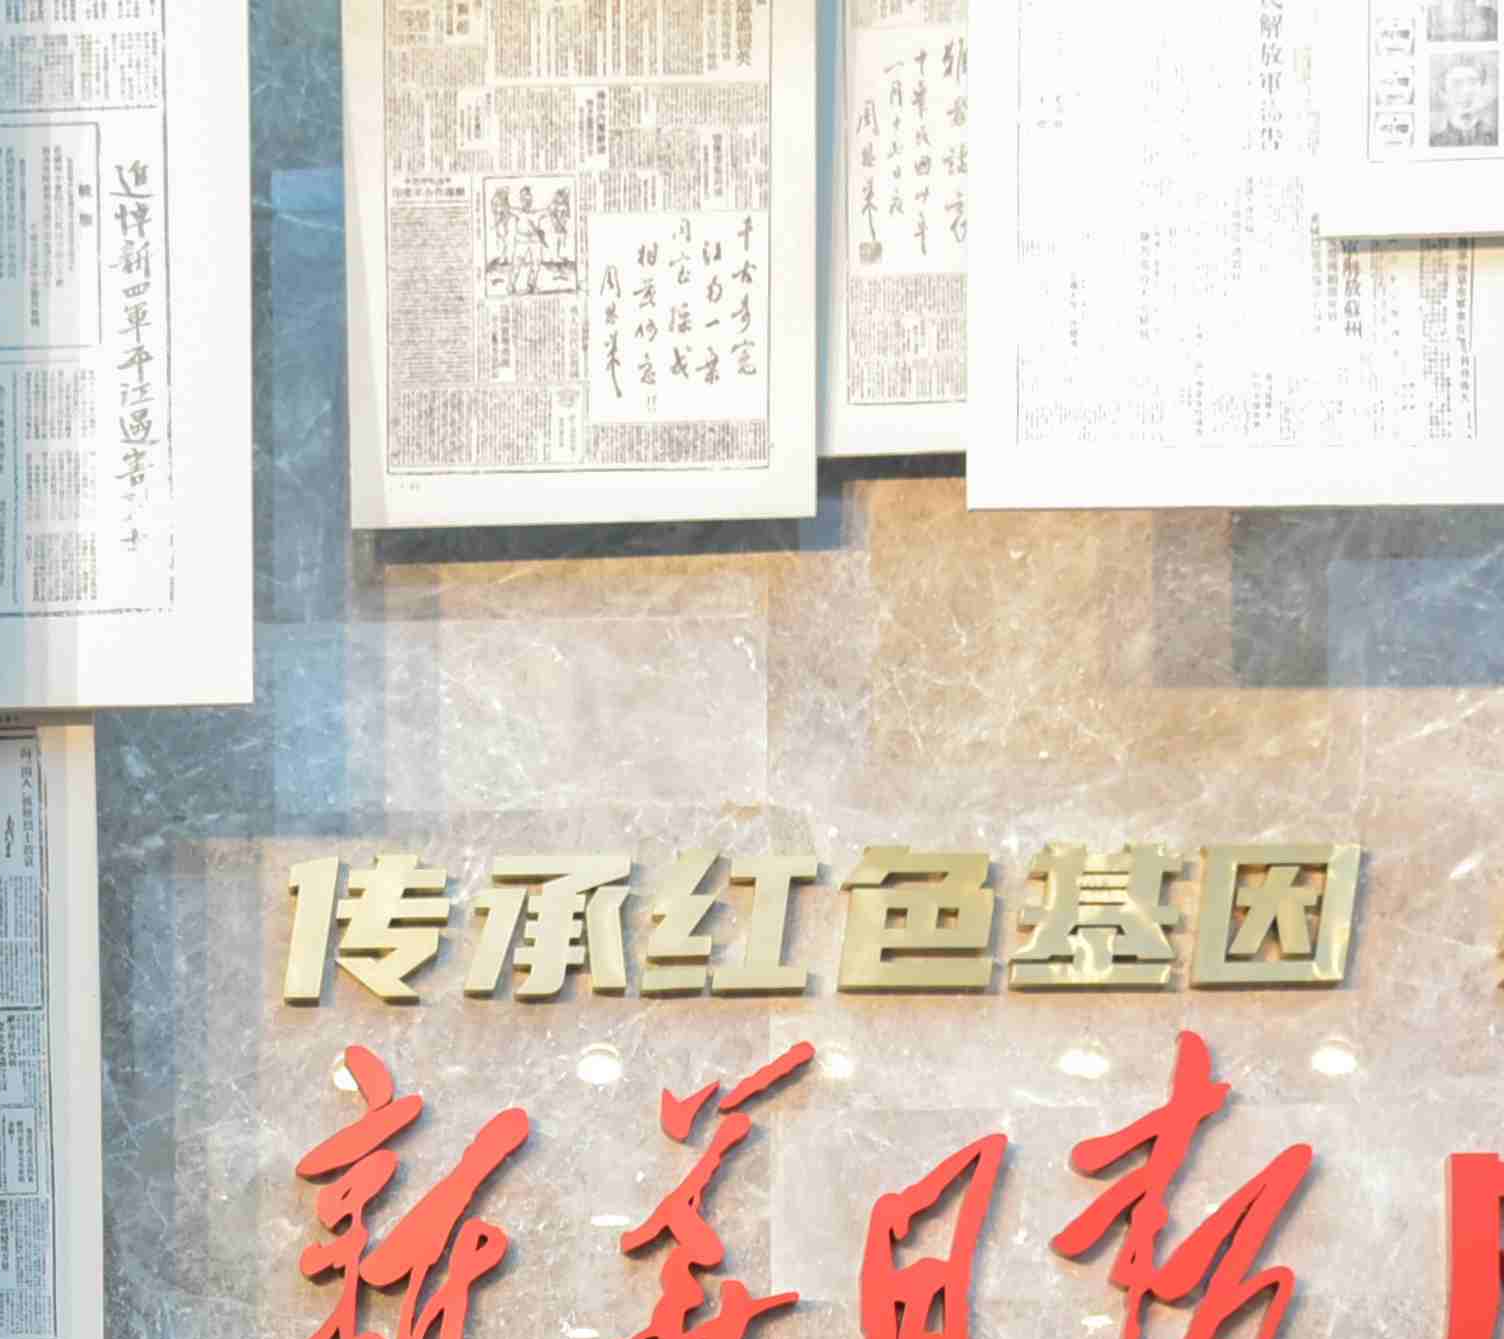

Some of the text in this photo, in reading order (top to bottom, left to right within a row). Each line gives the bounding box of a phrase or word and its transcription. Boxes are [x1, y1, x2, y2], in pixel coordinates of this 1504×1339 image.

[282, 842, 1362, 1003] 传承红色基因
